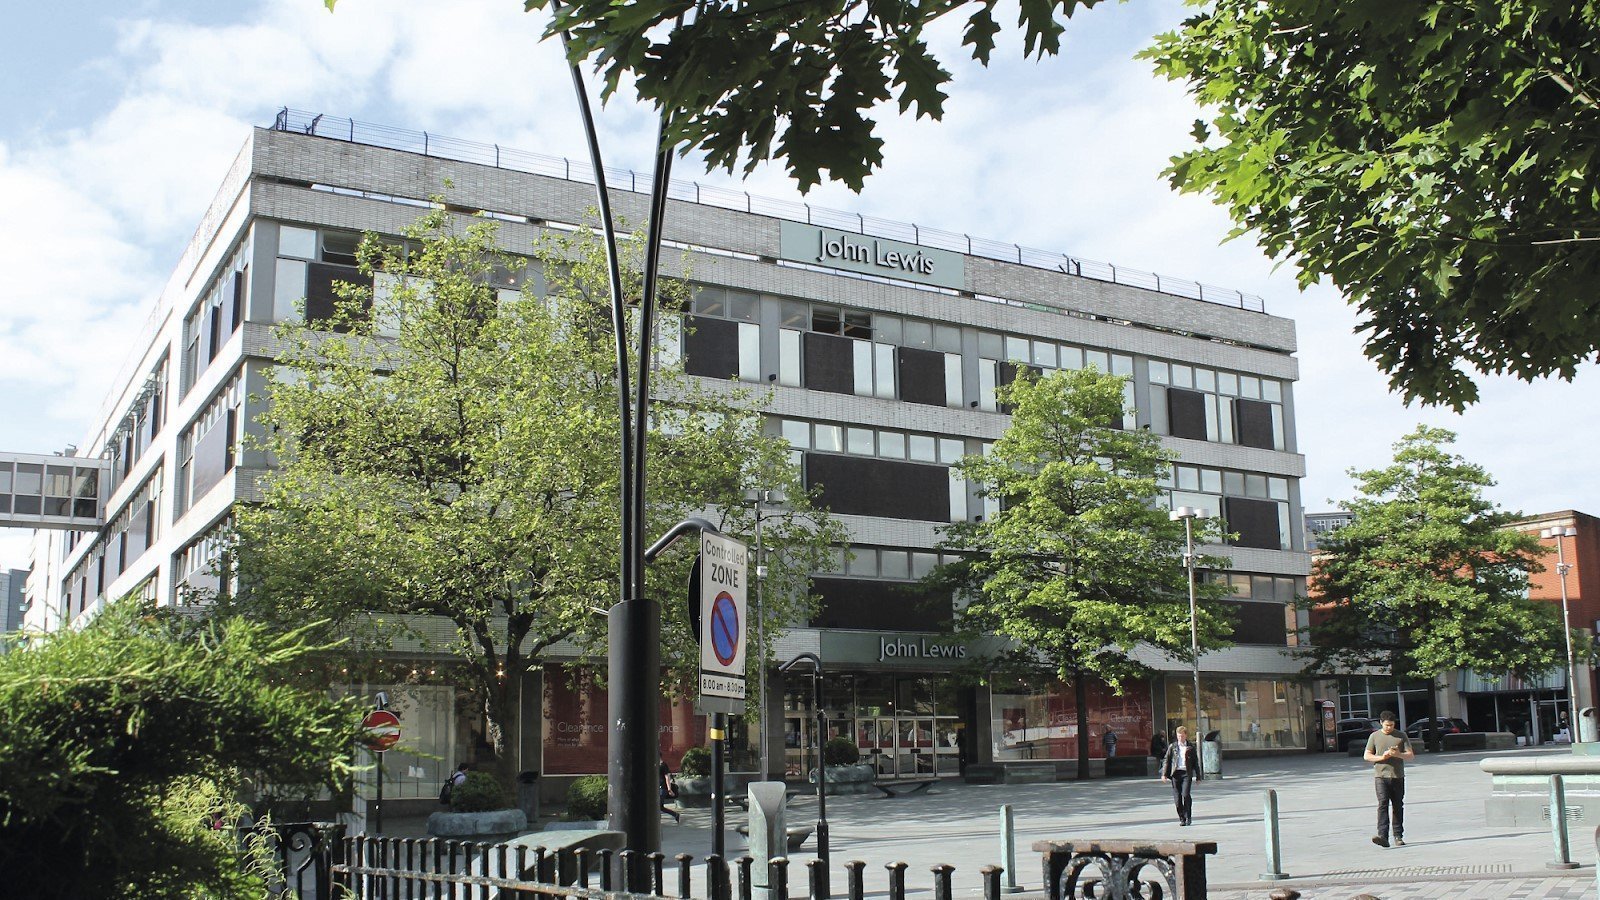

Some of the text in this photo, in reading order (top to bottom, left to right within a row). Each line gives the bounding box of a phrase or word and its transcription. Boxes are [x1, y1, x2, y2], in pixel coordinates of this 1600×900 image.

[817, 229, 935, 275] John Lewis
[705, 539, 745, 566] Controlled
[711, 562, 739, 589] ZONE
[879, 636, 966, 661] John Lewis
[702, 678, 716, 690] 8.00
[716, 682, 724, 691] am
